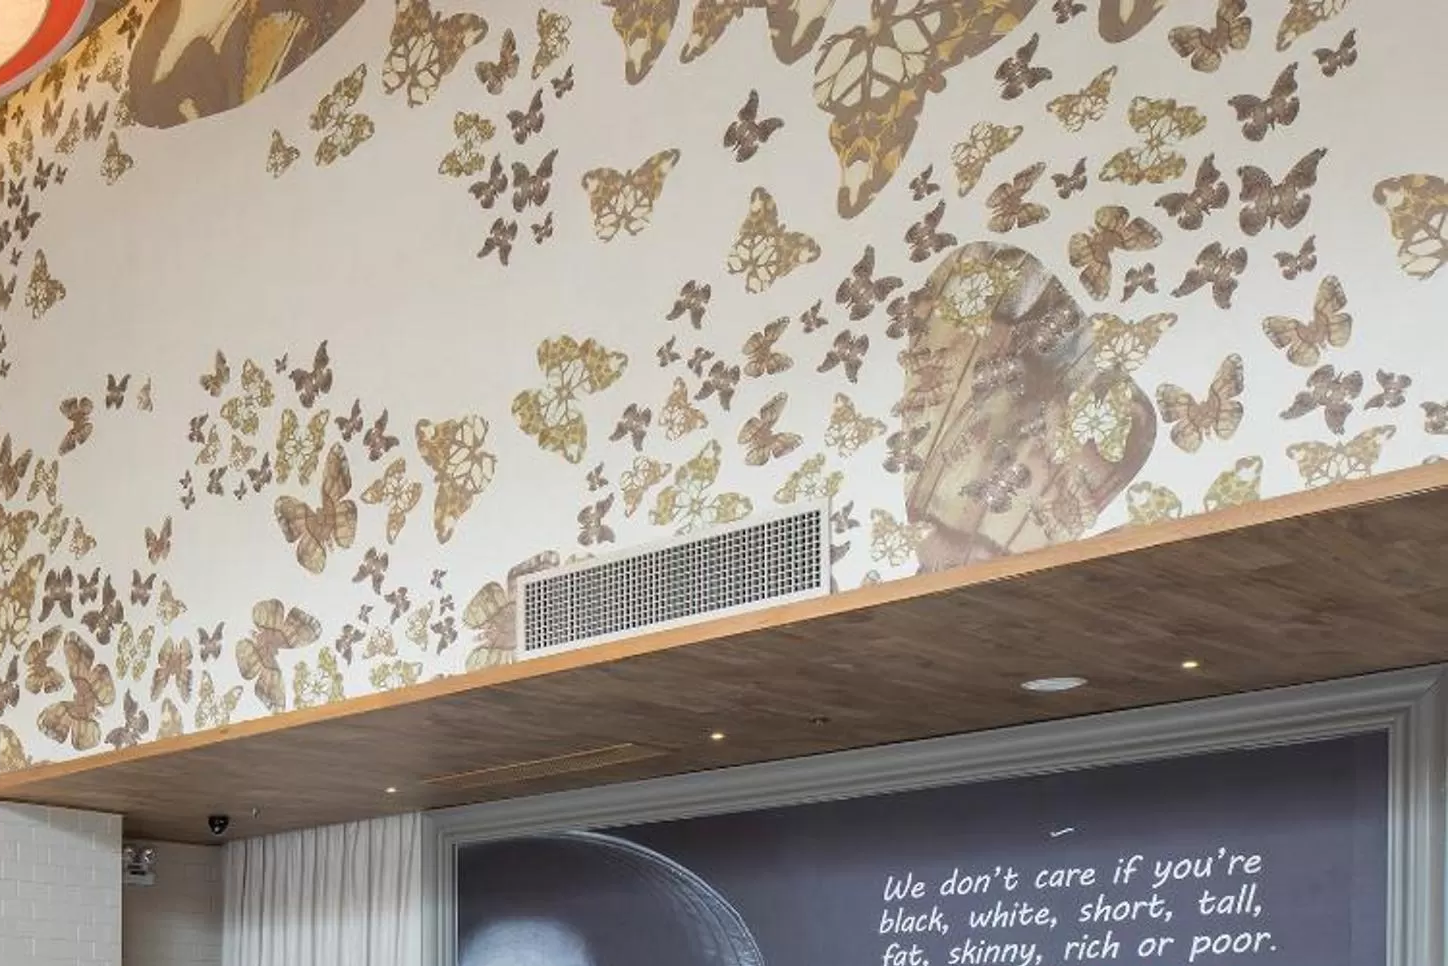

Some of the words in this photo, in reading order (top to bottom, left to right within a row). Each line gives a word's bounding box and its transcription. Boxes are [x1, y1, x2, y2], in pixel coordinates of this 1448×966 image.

[884, 872, 925, 901] We
[940, 866, 1018, 896] don't
[1034, 868, 1095, 889] care
[1113, 855, 1143, 884] if
[1152, 847, 1261, 889] you're
[879, 906, 949, 935] black,
[969, 901, 1057, 928] white,
[1078, 894, 1172, 922] short,
[1198, 883, 1261, 917] tall,
[1064, 930, 1120, 960] rich
[1138, 937, 1174, 957] or
[1189, 932, 1276, 962] poor.
